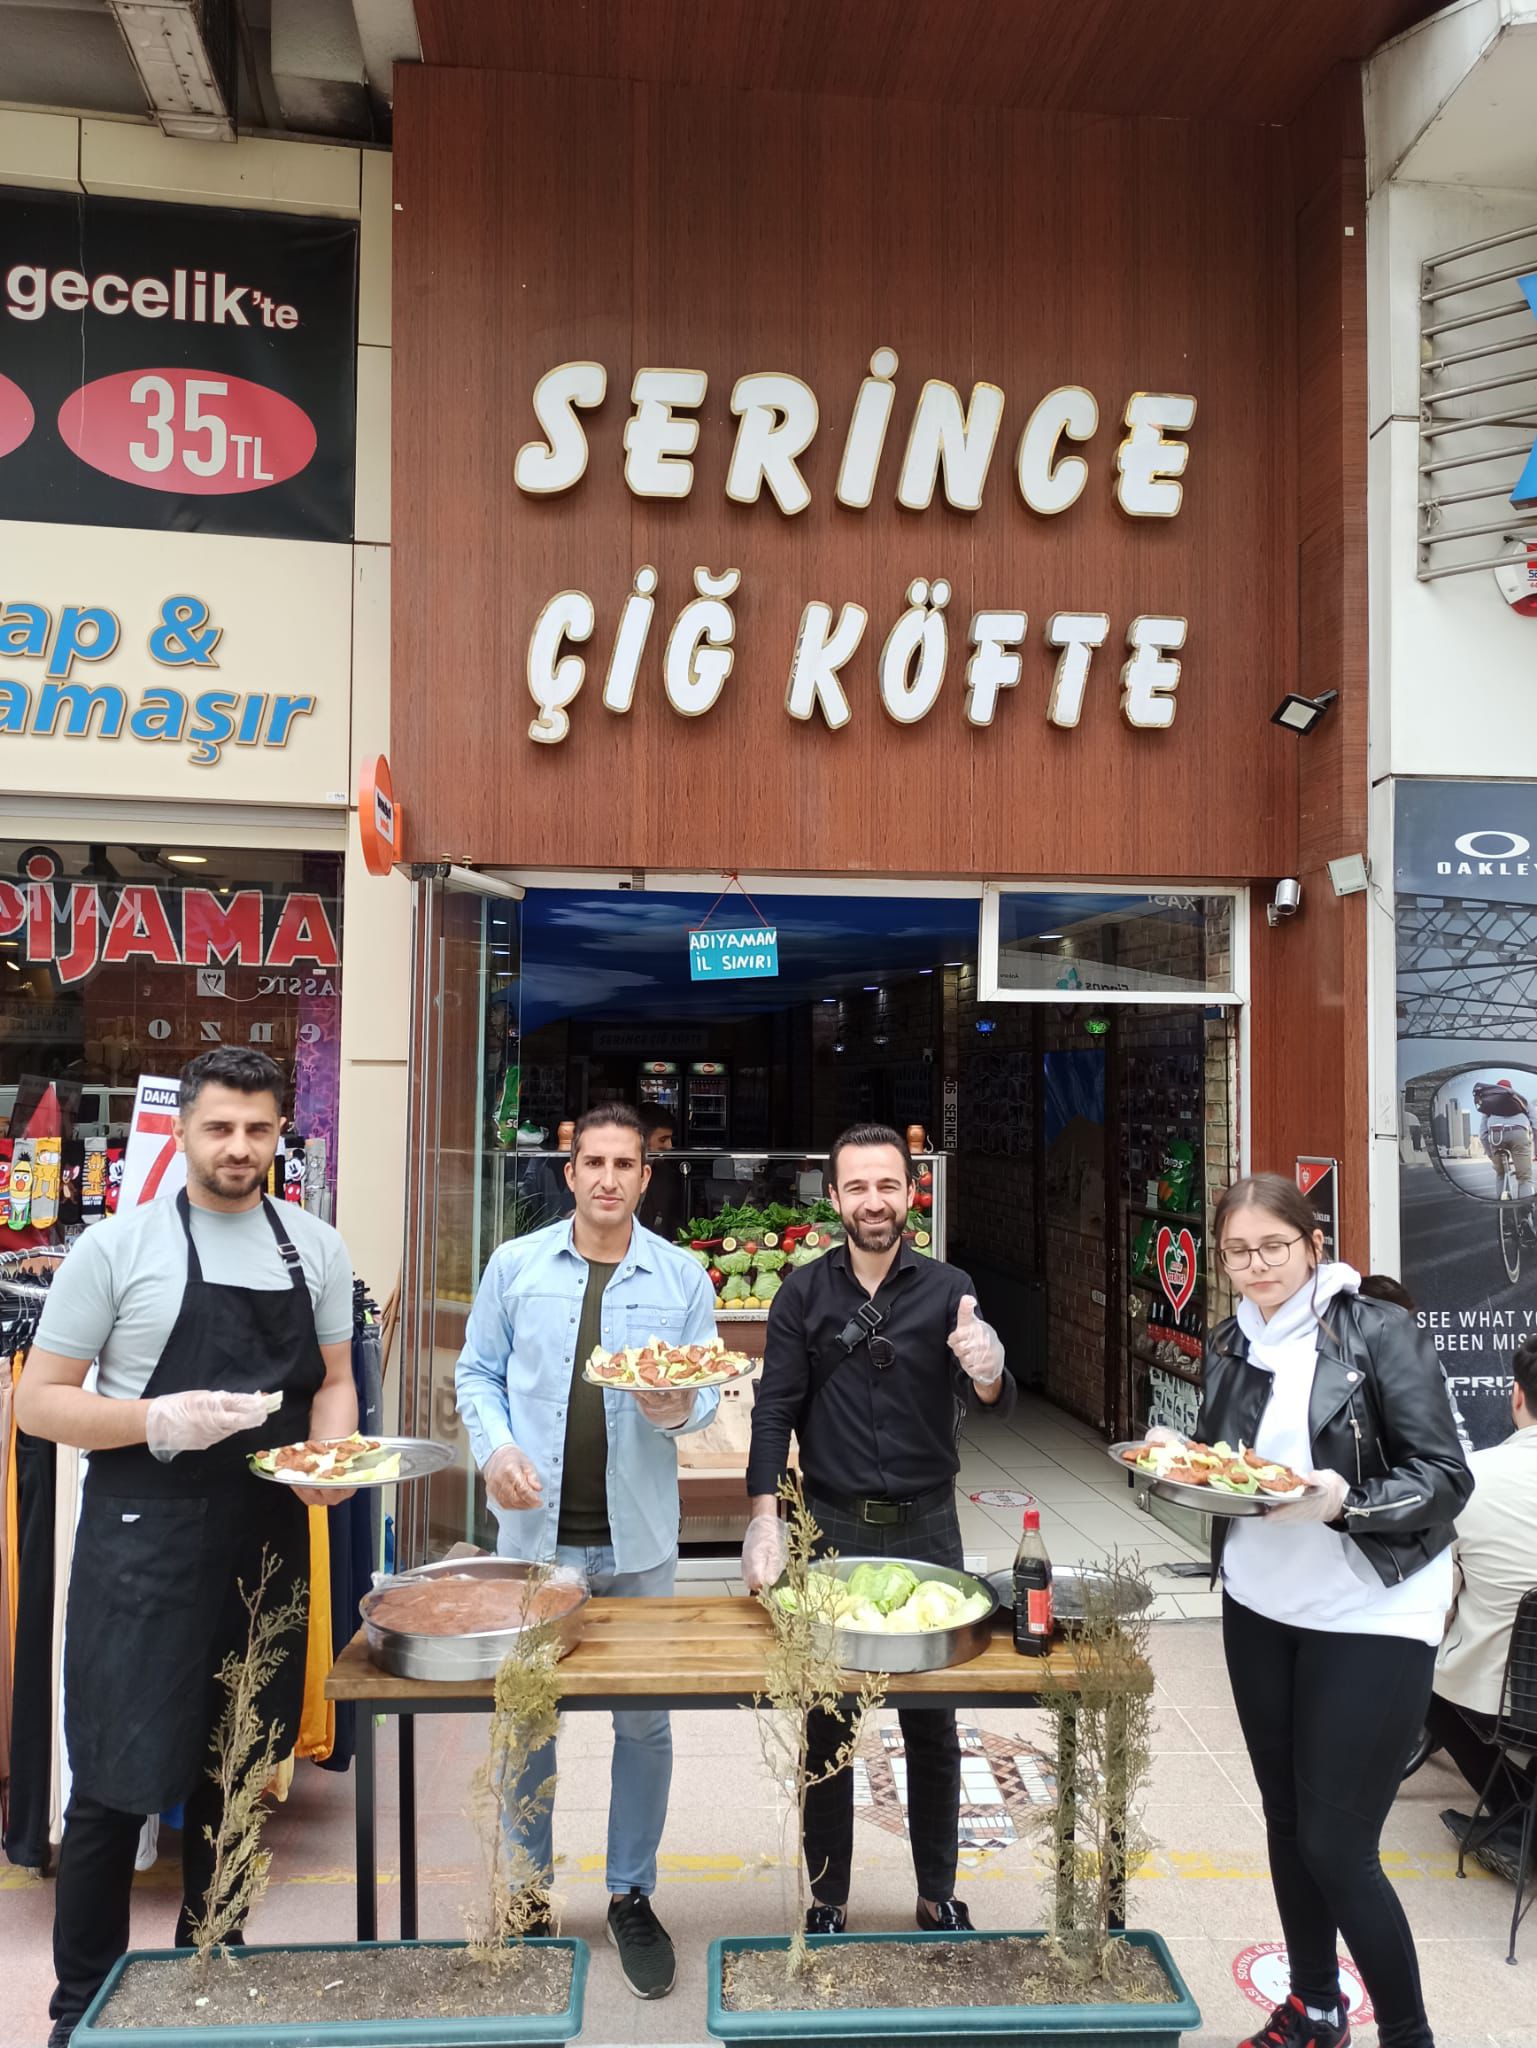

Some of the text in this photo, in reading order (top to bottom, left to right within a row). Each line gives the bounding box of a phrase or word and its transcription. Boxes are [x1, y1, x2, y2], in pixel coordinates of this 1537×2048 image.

[513, 346, 1198, 517] SERİNCE
[0, 593, 223, 678] ap &
[527, 564, 1188, 744] ÇİĞ KÖFTE
[1437, 861, 1537, 876] OAKLE
[689, 930, 777, 951] ADIYAMAN
[695, 951, 772, 972] İL SINIRI
[143, 1089, 178, 1106] DAHA
[1416, 1310, 1537, 1329] SEE WHAT Y
[1434, 1332, 1537, 1351] BEEN MIS
